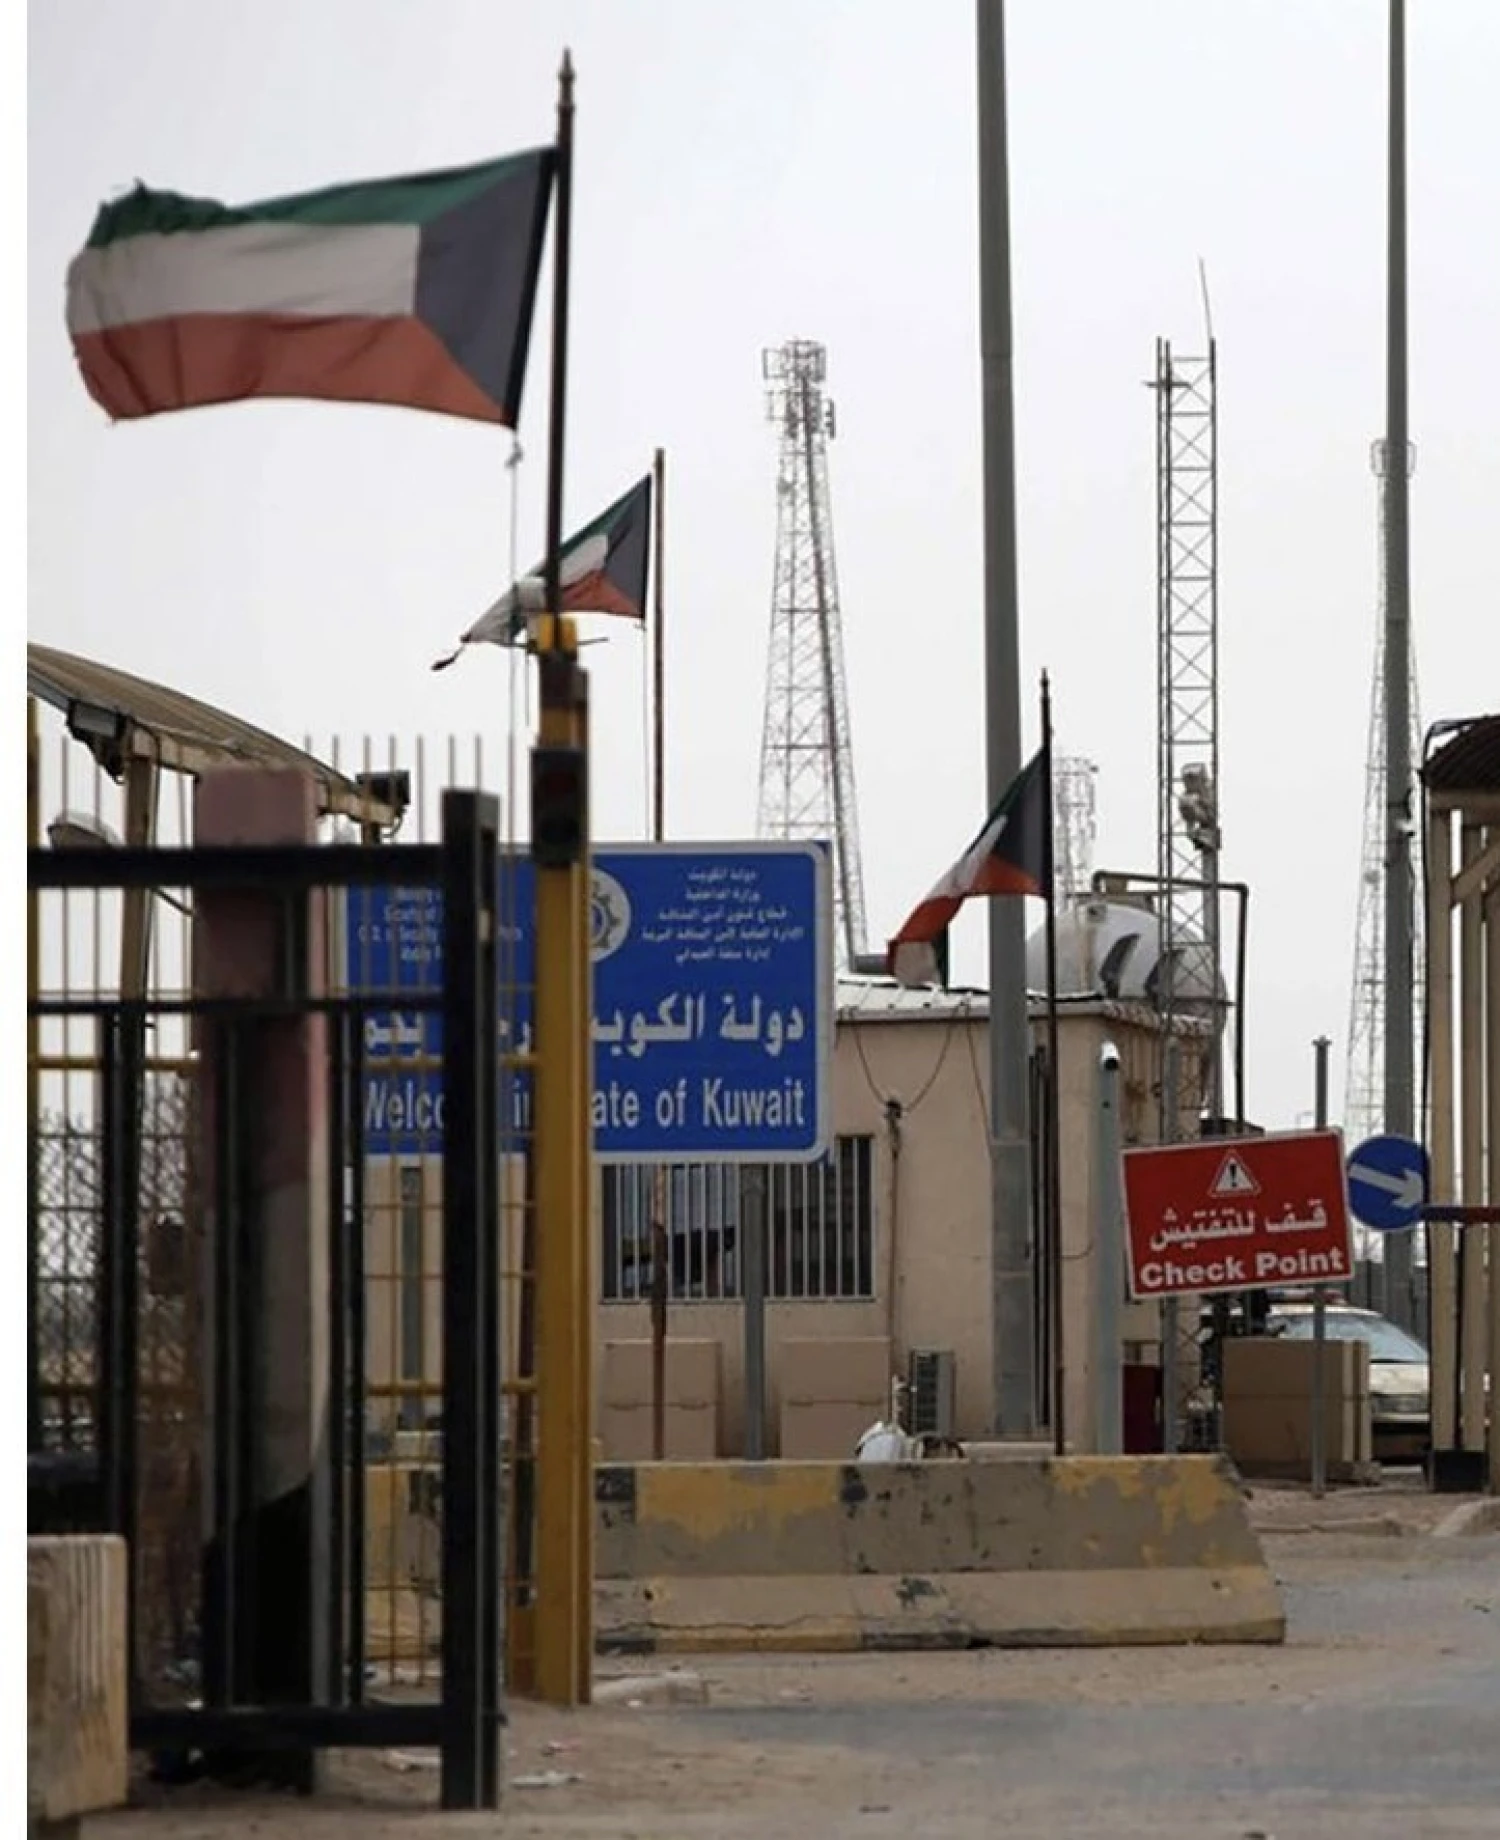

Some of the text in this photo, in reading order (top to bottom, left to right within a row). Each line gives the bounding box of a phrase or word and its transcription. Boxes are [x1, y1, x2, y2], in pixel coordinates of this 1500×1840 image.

[719, 993, 804, 1057] دولة
[592, 1080, 641, 1129] ate
[655, 1077, 687, 1129] of
[702, 1077, 805, 1129] Kuwait
[1149, 1206, 1256, 1252] للتفتيش
[1139, 1246, 1345, 1287] Check Point
